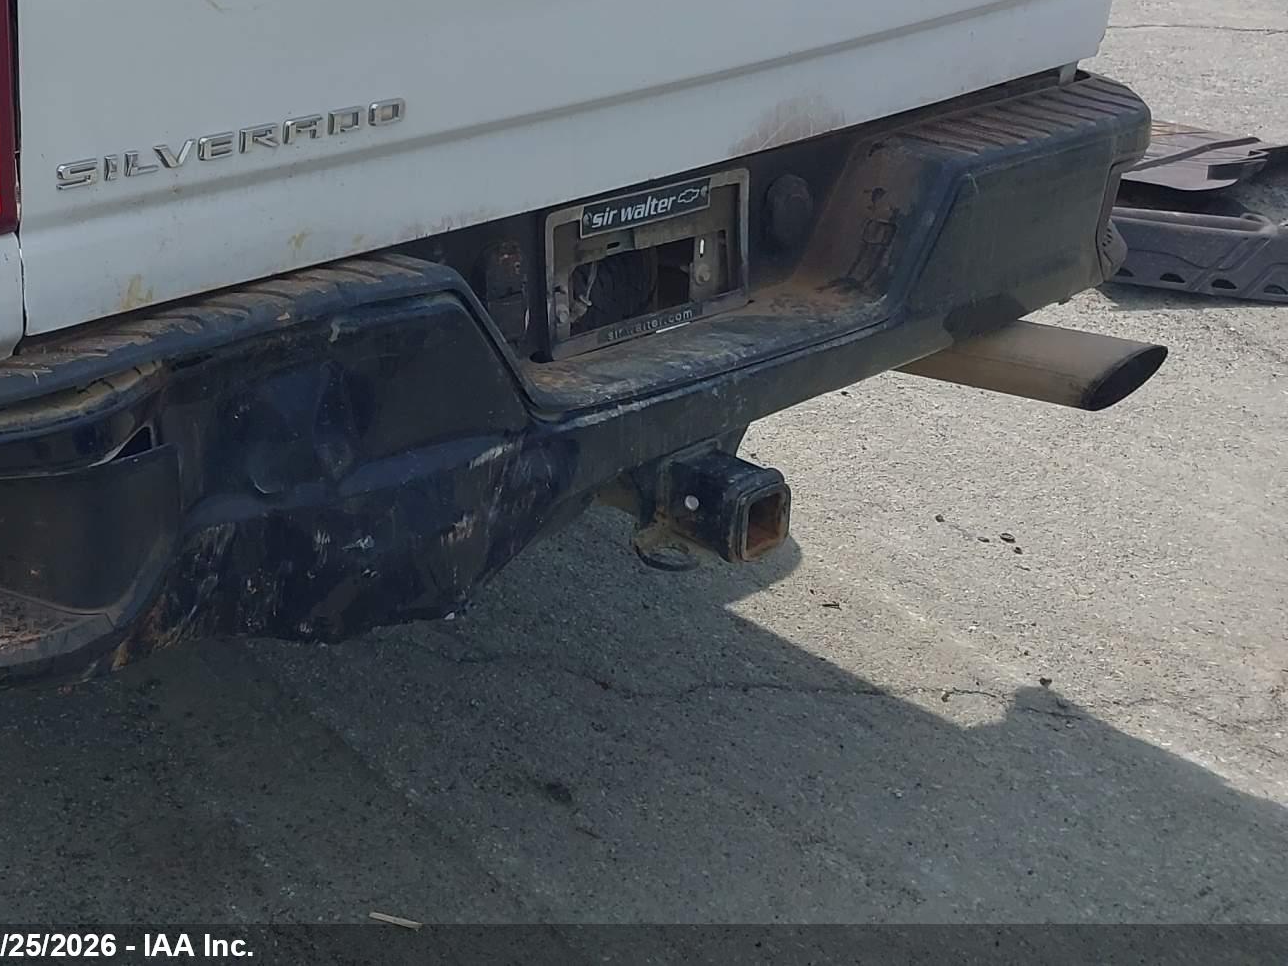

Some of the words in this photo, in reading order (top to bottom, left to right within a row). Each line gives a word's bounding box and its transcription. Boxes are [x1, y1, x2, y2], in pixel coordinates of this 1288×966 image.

[56, 97, 407, 190] SILVERADO
[591, 207, 616, 229] sir
[620, 194, 676, 223] walter
